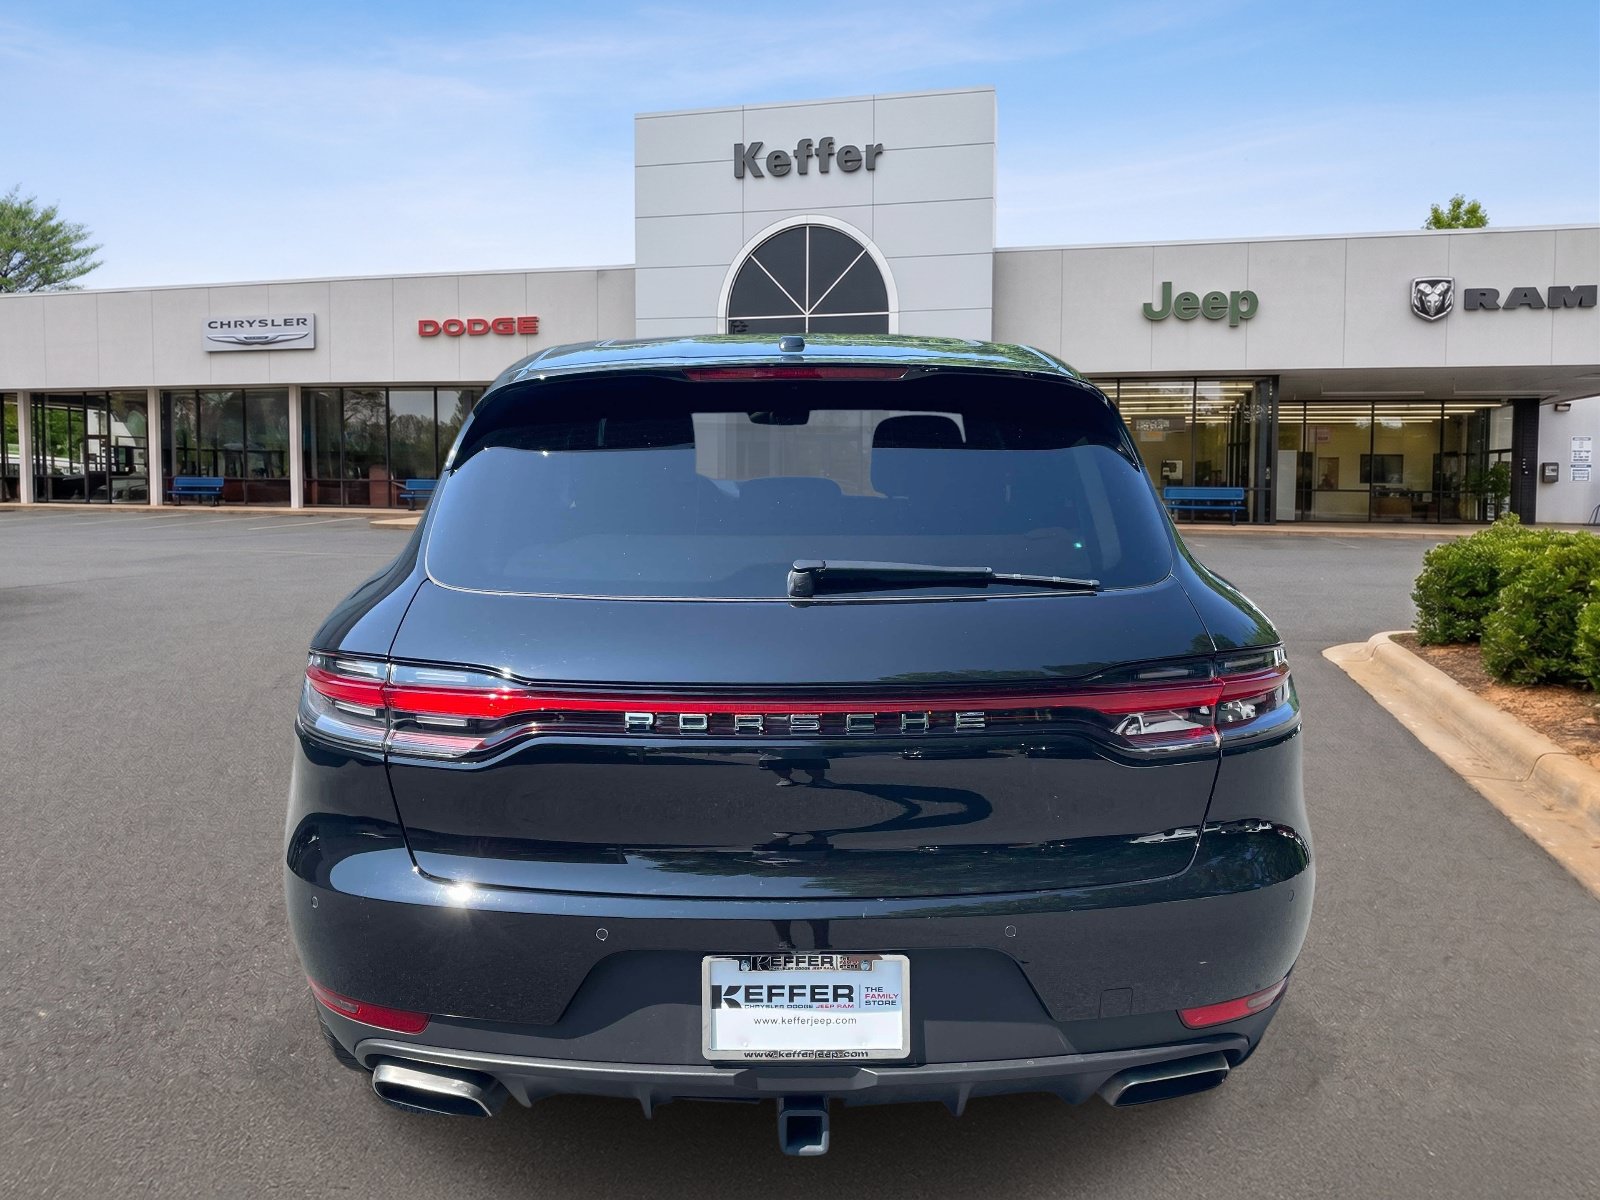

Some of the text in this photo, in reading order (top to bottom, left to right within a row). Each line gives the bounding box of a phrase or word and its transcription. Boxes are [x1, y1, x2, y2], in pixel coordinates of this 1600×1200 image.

[734, 136, 883, 178] Keffer
[1143, 281, 1259, 327] Jeep
[1464, 285, 1598, 310] RAM
[207, 318, 308, 329] CHRYSLER
[418, 316, 539, 337] DODGE
[625, 711, 985, 733] PORSCHE
[751, 956, 834, 970] KEFFER
[711, 985, 854, 1009] KEFFER
[754, 1016, 857, 1027] www.kefferjeep.com
[744, 1050, 869, 1059] www.kefferjeep.com
